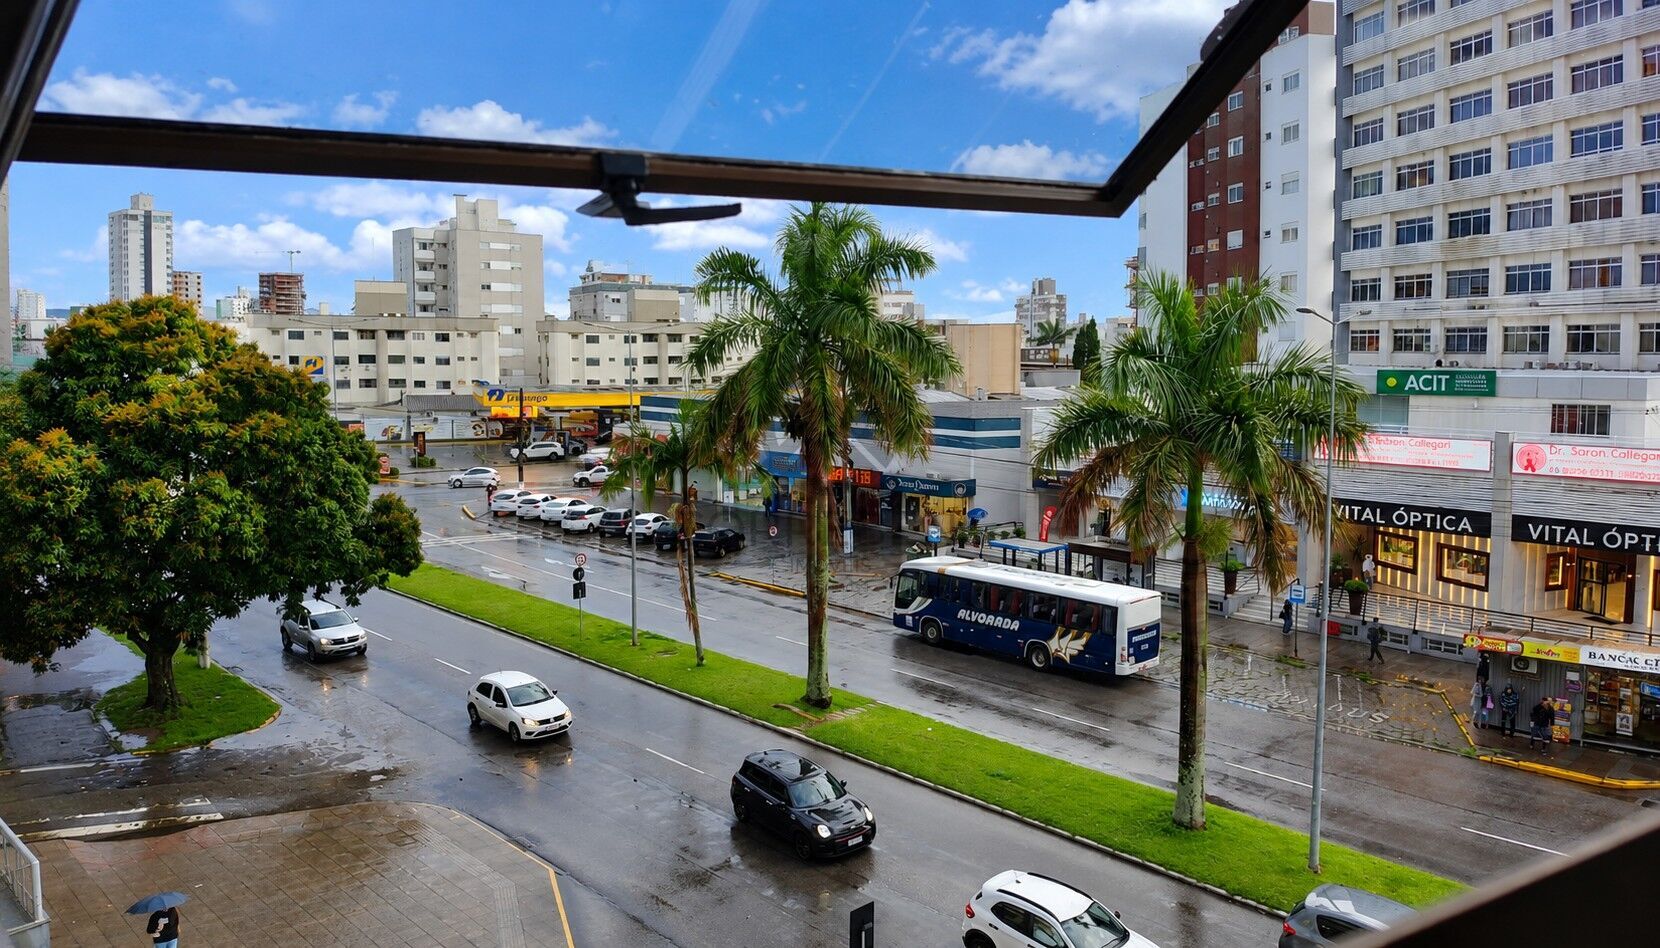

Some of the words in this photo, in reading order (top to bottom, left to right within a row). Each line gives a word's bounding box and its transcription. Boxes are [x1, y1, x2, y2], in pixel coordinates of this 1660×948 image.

[1404, 374, 1450, 392] ACIT
[1549, 445, 1565, 456] Dr.
[1333, 504, 1385, 524] VITAL
[1392, 507, 1473, 533] ÓPTICA
[1528, 523, 1595, 546] VITAL
[957, 608, 1020, 632] ALVORADA
